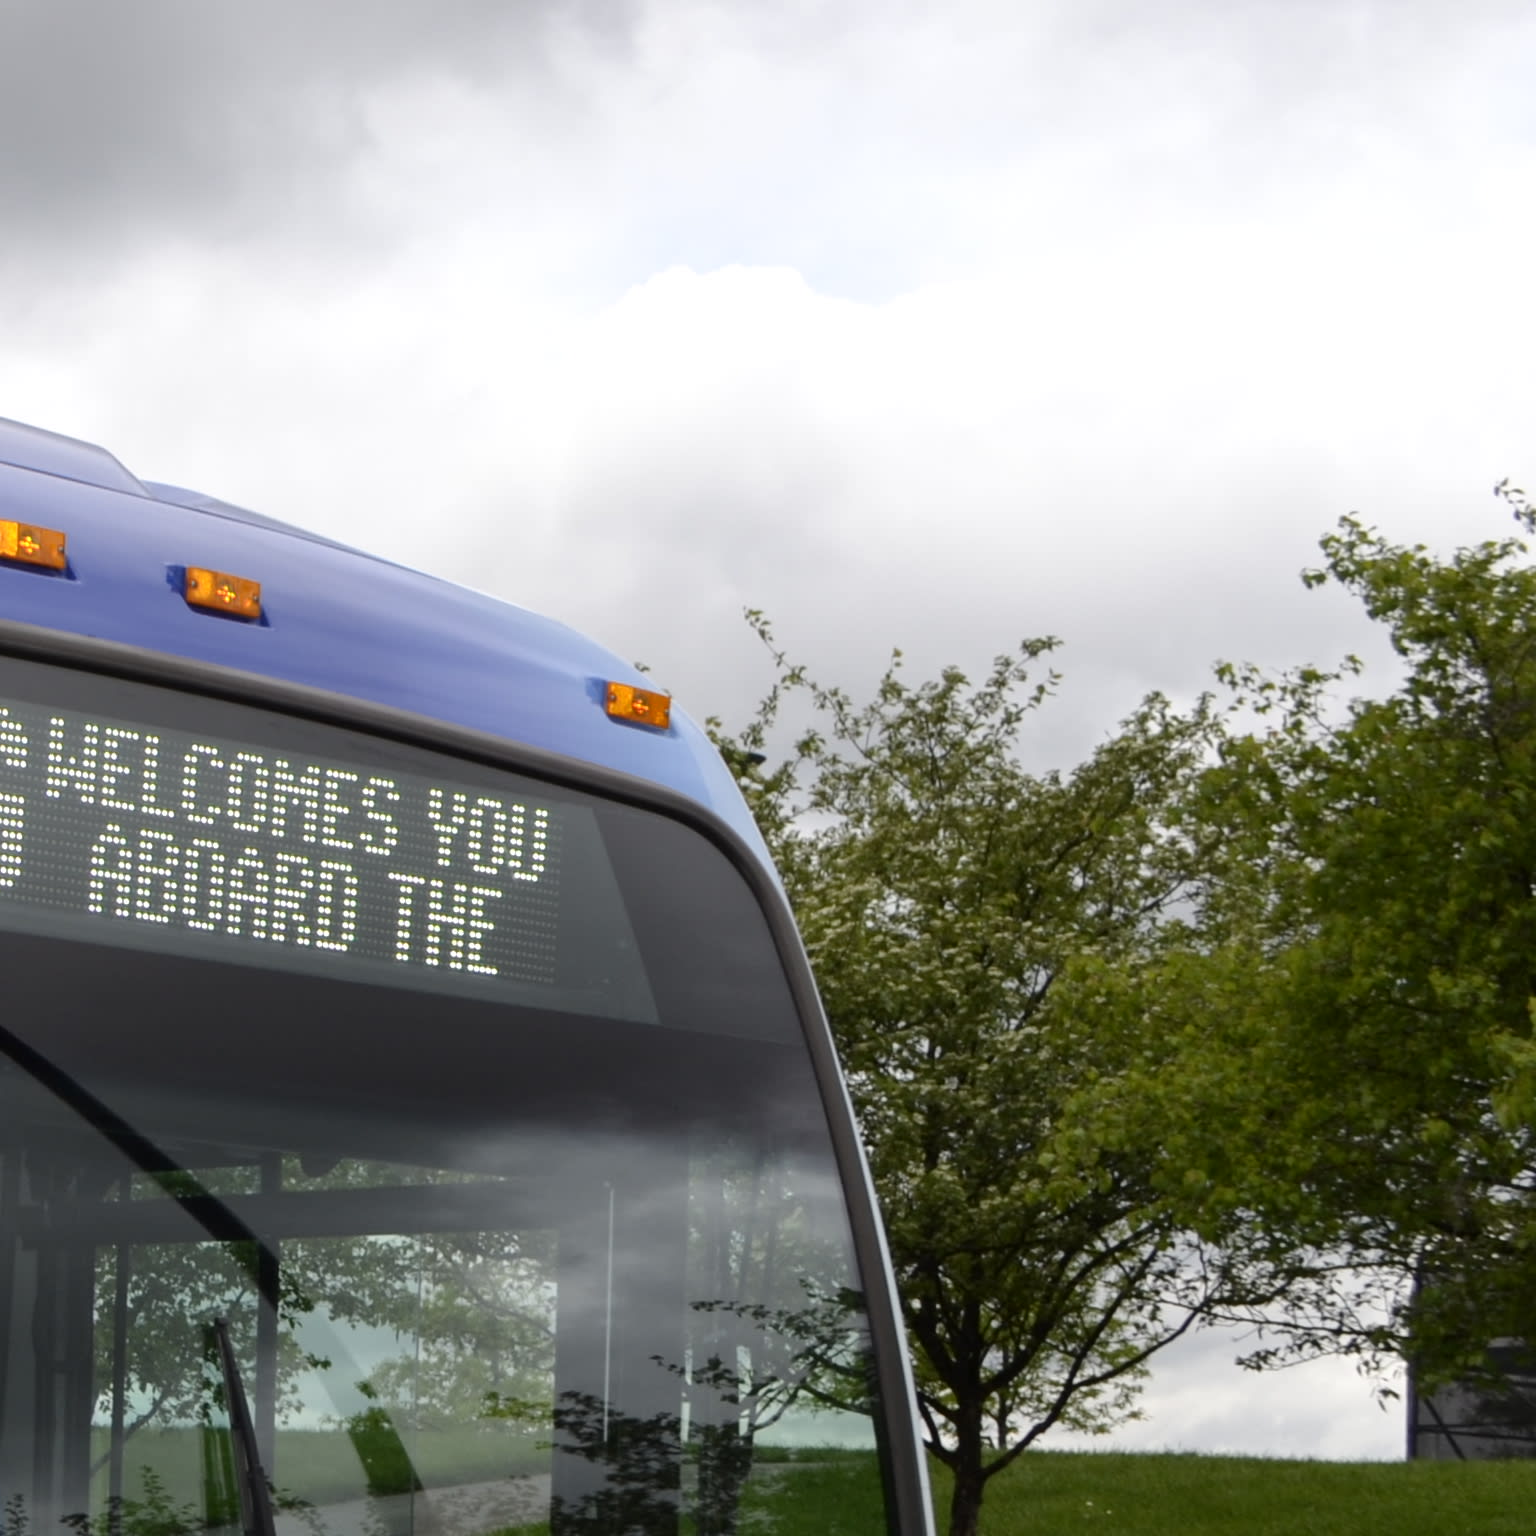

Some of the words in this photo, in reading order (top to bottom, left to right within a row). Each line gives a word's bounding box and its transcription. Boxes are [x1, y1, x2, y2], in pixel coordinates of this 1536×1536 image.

[46, 716, 401, 856] WELCOMES
[426, 788, 551, 883] YOU
[87, 823, 358, 952] ABOARD
[388, 869, 504, 976] THE
